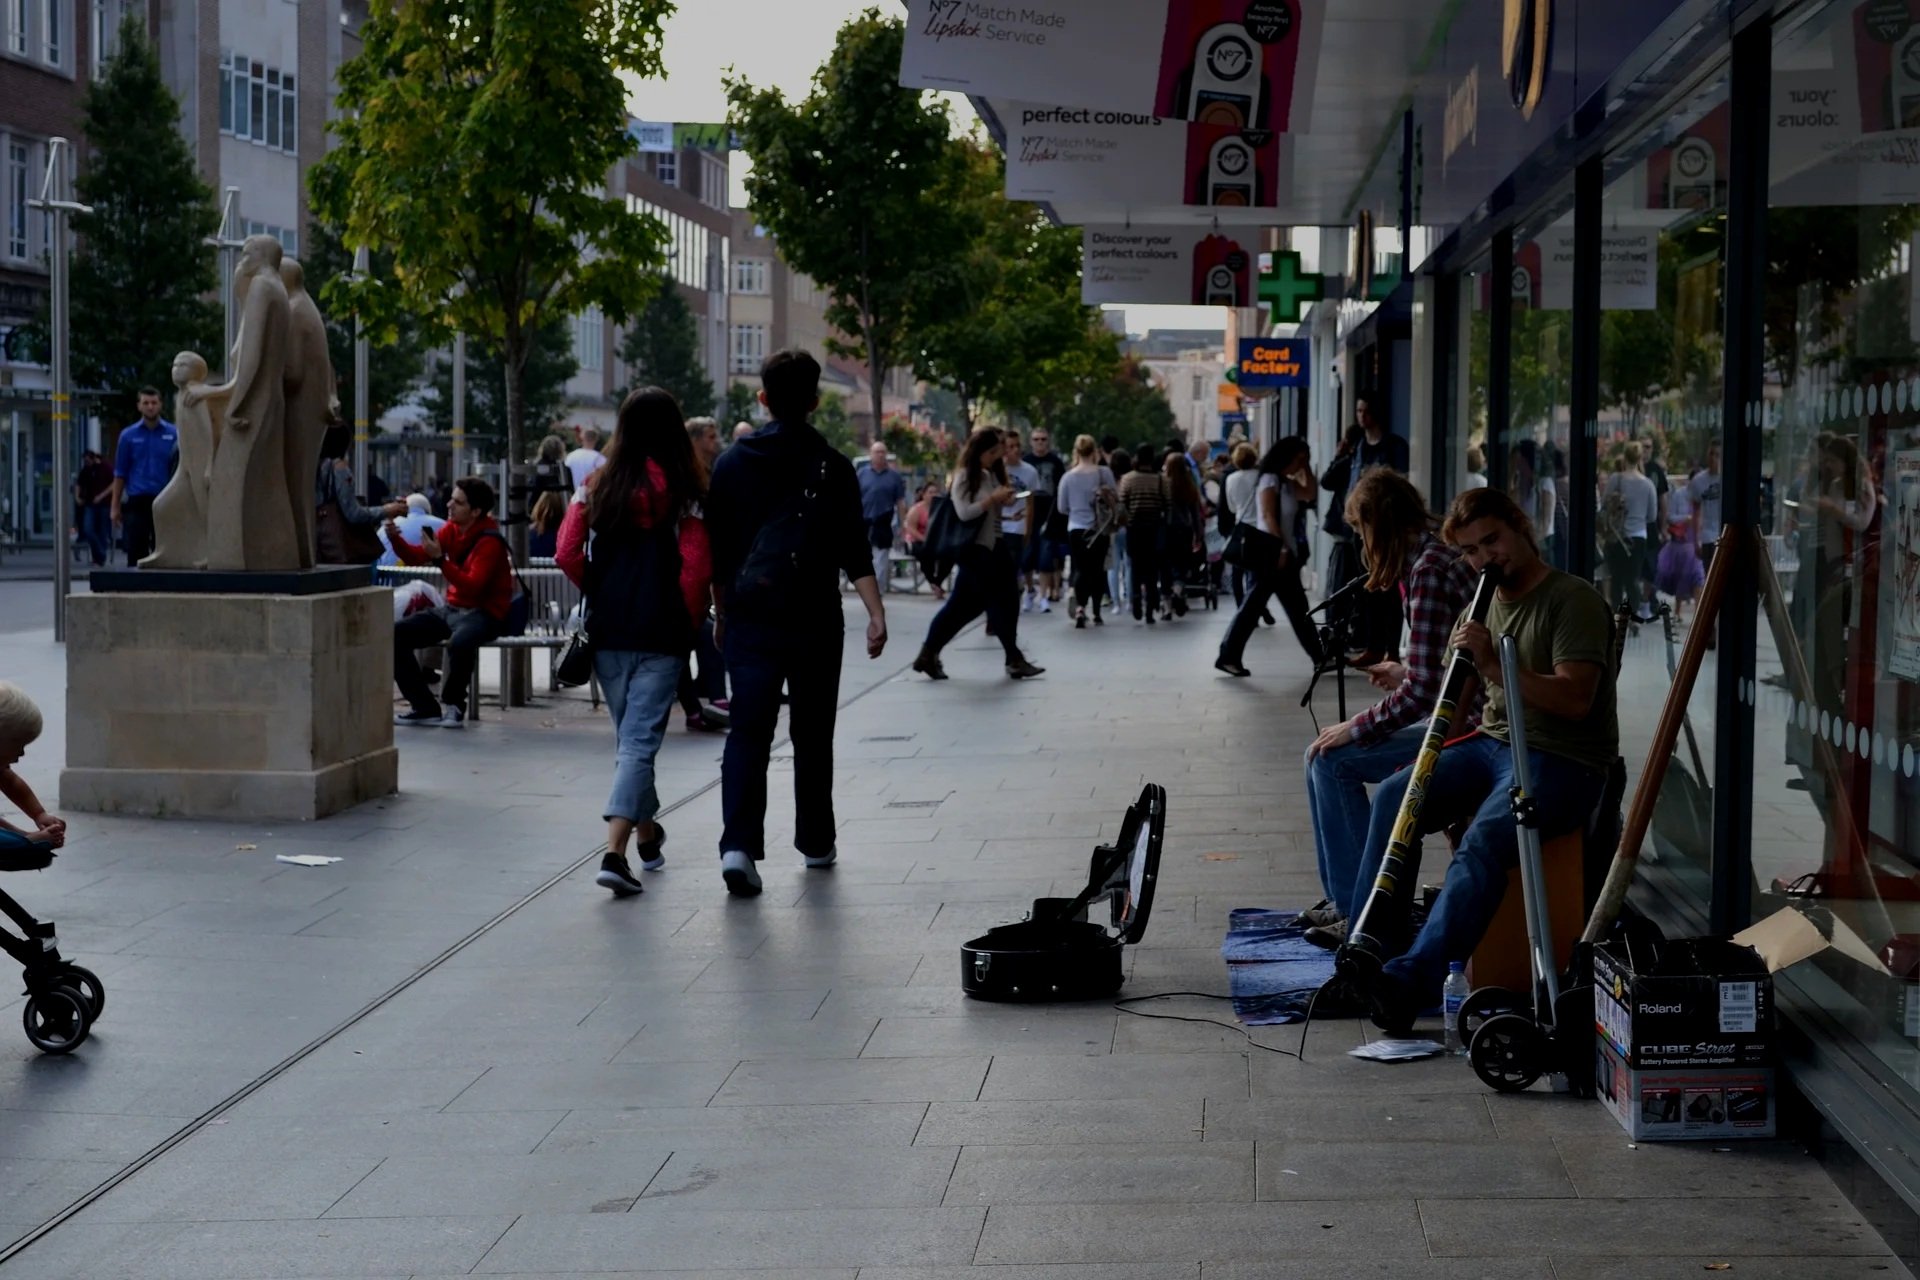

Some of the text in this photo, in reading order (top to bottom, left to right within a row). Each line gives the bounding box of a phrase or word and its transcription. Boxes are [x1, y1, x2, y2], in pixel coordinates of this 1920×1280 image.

[965, 3, 1016, 22] Match
[1020, 9, 1065, 28] Made
[985, 24, 1046, 45] Service
[1022, 106, 1090, 126] perfect
[1047, 137, 1082, 149] Match
[1085, 138, 1118, 149] Made
[1092, 233, 1172, 247] Discover your
[1092, 249, 1178, 261] perfect colours
[1252, 346, 1290, 361] Card
[1241, 360, 1301, 377] Factory
[1639, 1003, 1682, 1014] Roland
[1640, 1045, 1692, 1055] CUBE
[1693, 1041, 1736, 1057] Street
